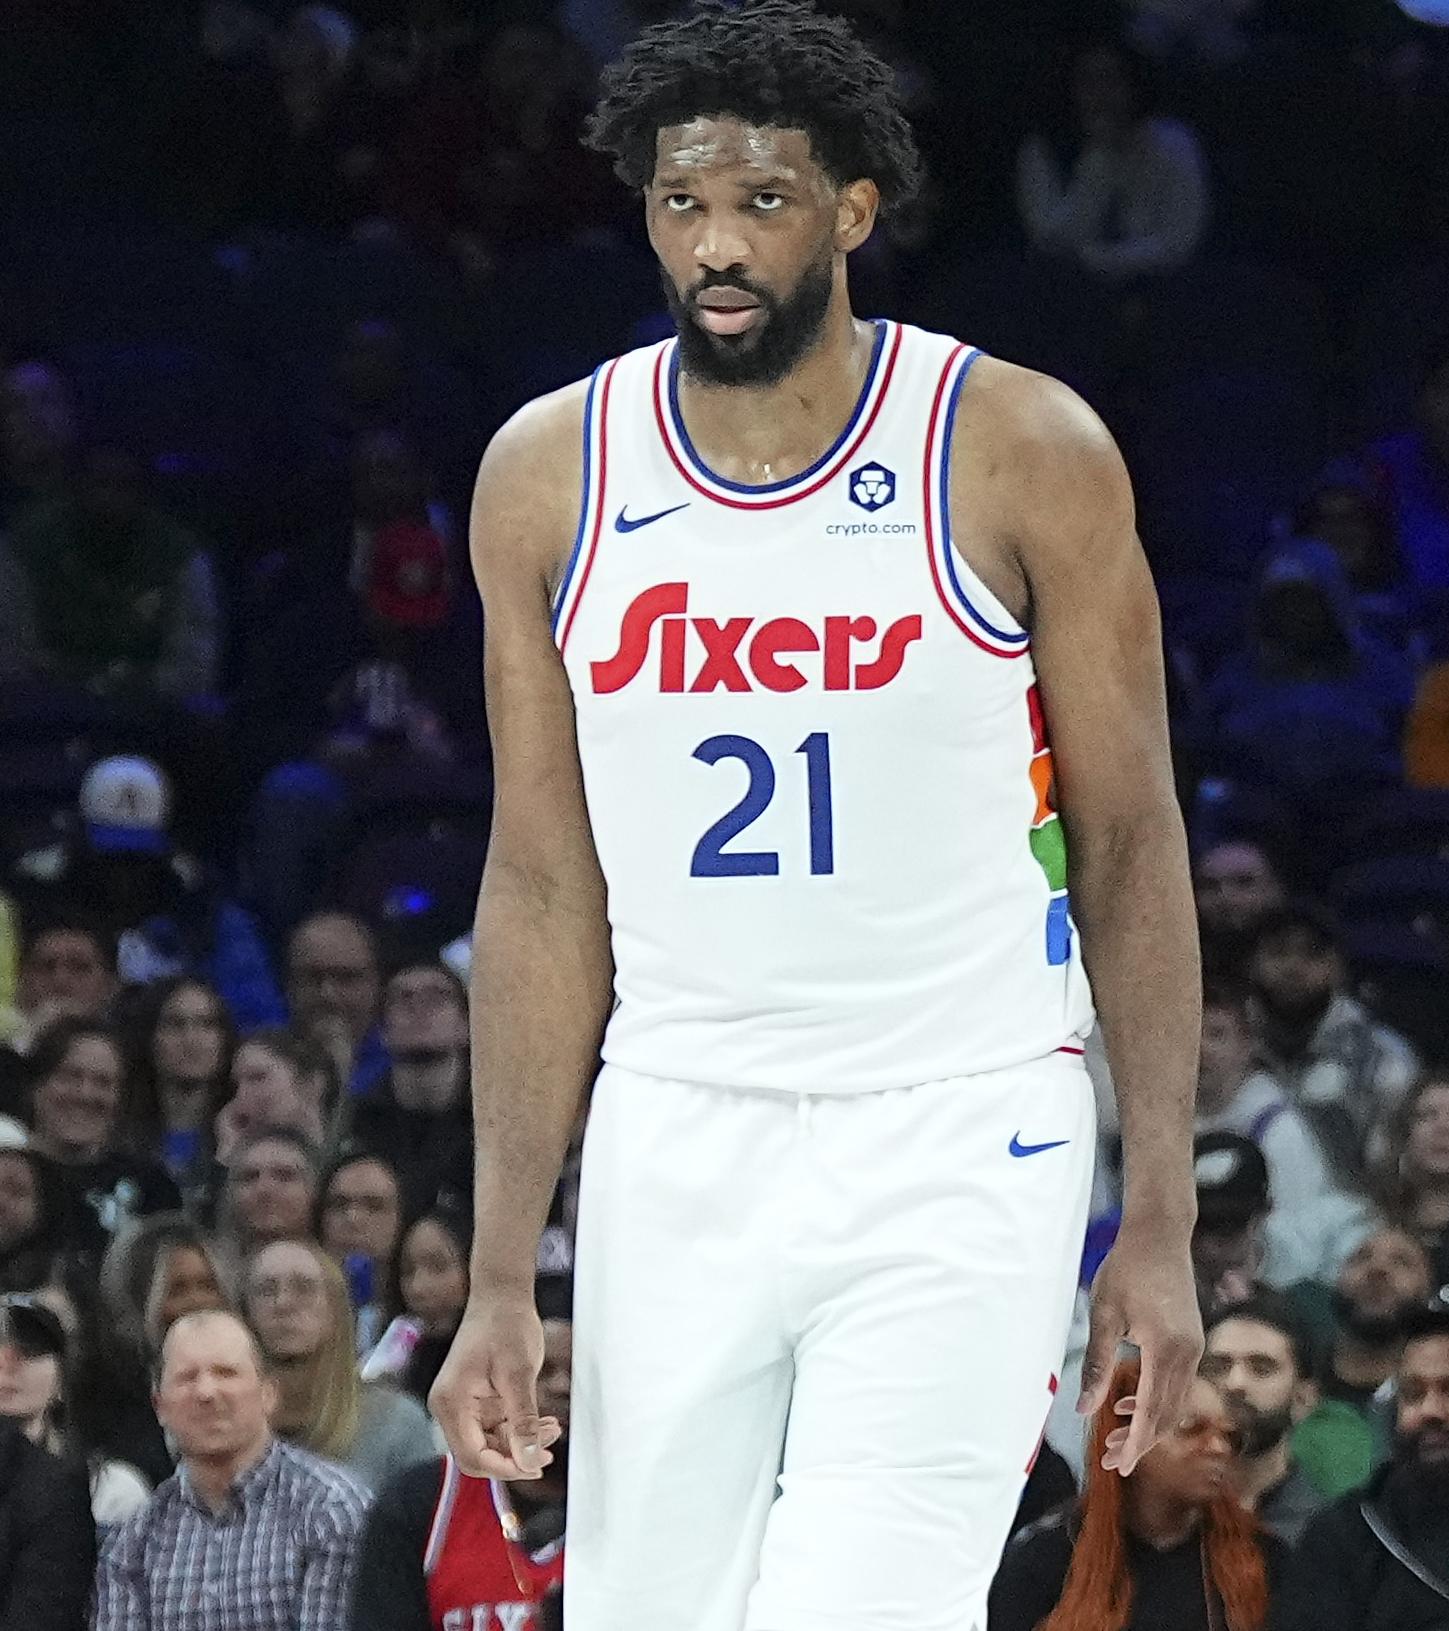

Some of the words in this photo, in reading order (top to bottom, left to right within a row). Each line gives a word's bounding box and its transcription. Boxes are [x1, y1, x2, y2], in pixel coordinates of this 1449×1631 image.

[826, 522, 916, 536] crypto.com
[589, 582, 922, 694] Sixers
[689, 732, 835, 878] 21
